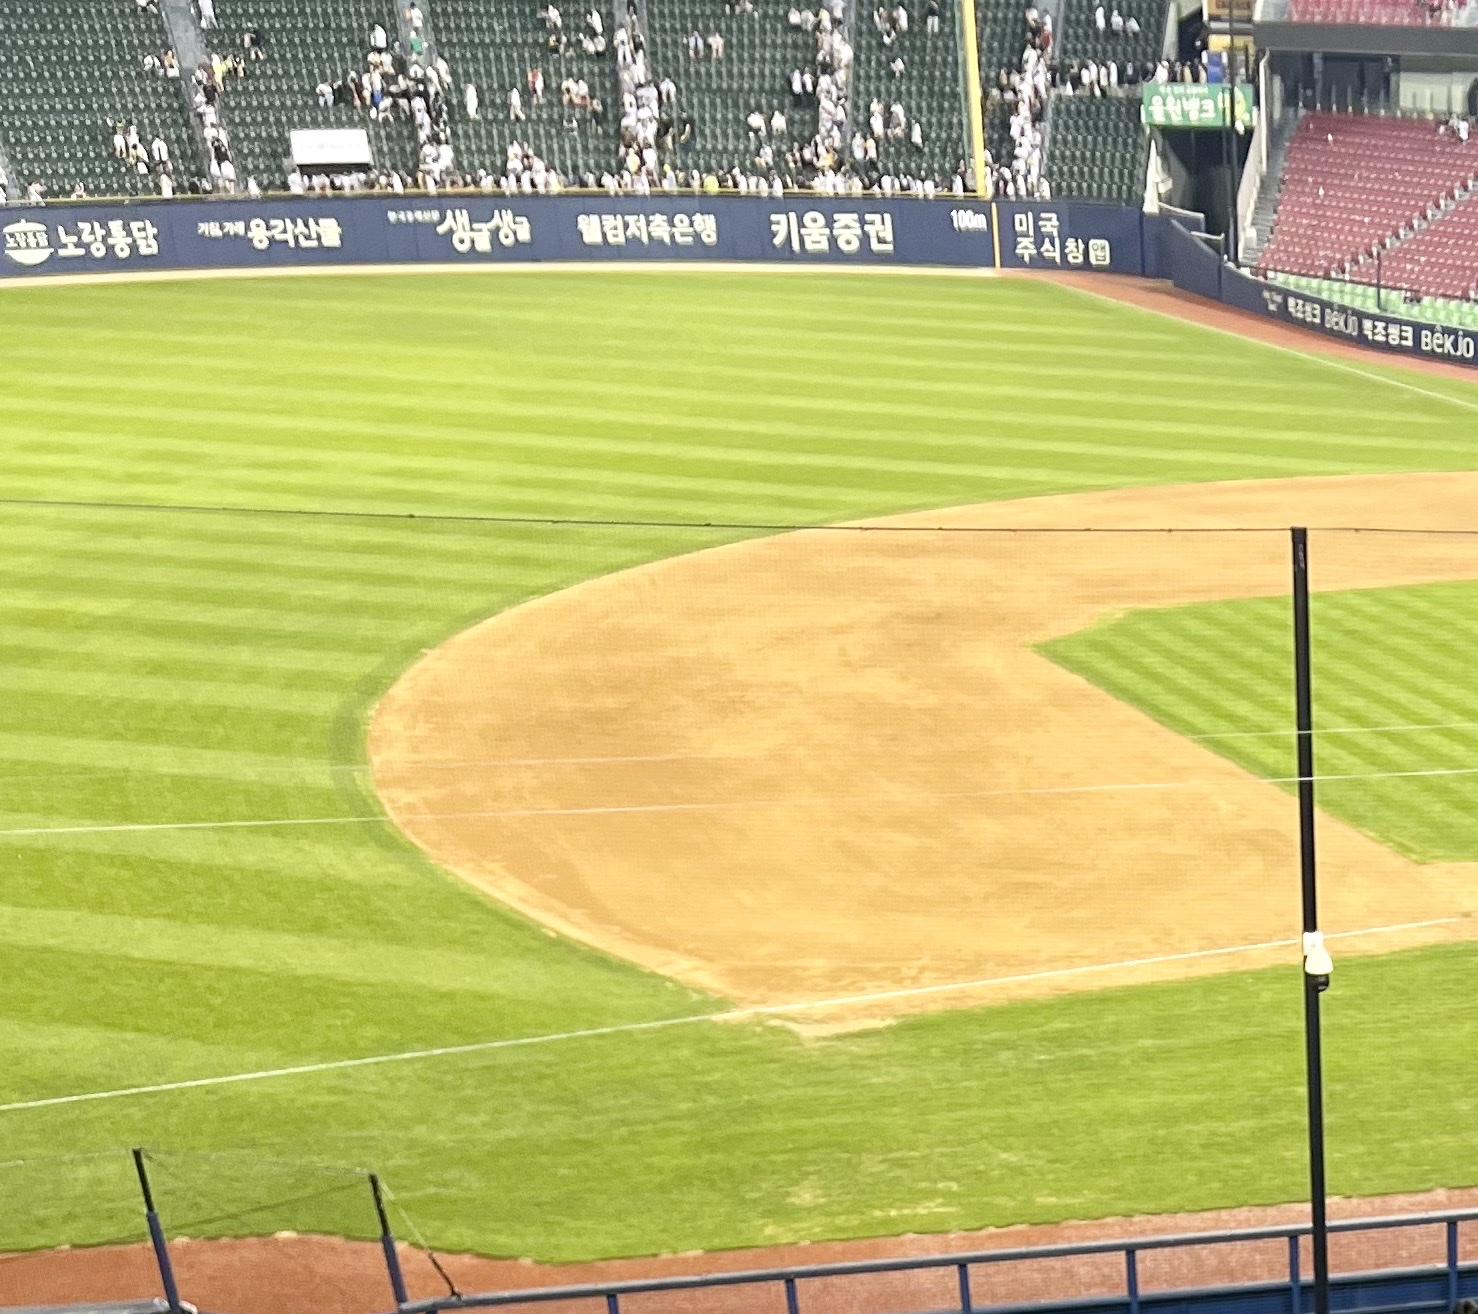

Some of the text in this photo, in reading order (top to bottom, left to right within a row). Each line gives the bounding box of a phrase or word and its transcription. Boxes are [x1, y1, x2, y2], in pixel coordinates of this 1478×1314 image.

[436, 208, 531, 253] 생글생글
[576, 212, 718, 246] 웰컴저축은행
[769, 210, 895, 253] 키움증권
[950, 209, 988, 232] 100m
[1014, 211, 1060, 238] 미국
[57, 219, 159, 259] 노랑통닭
[1362, 319, 1414, 348] 백조씽크
